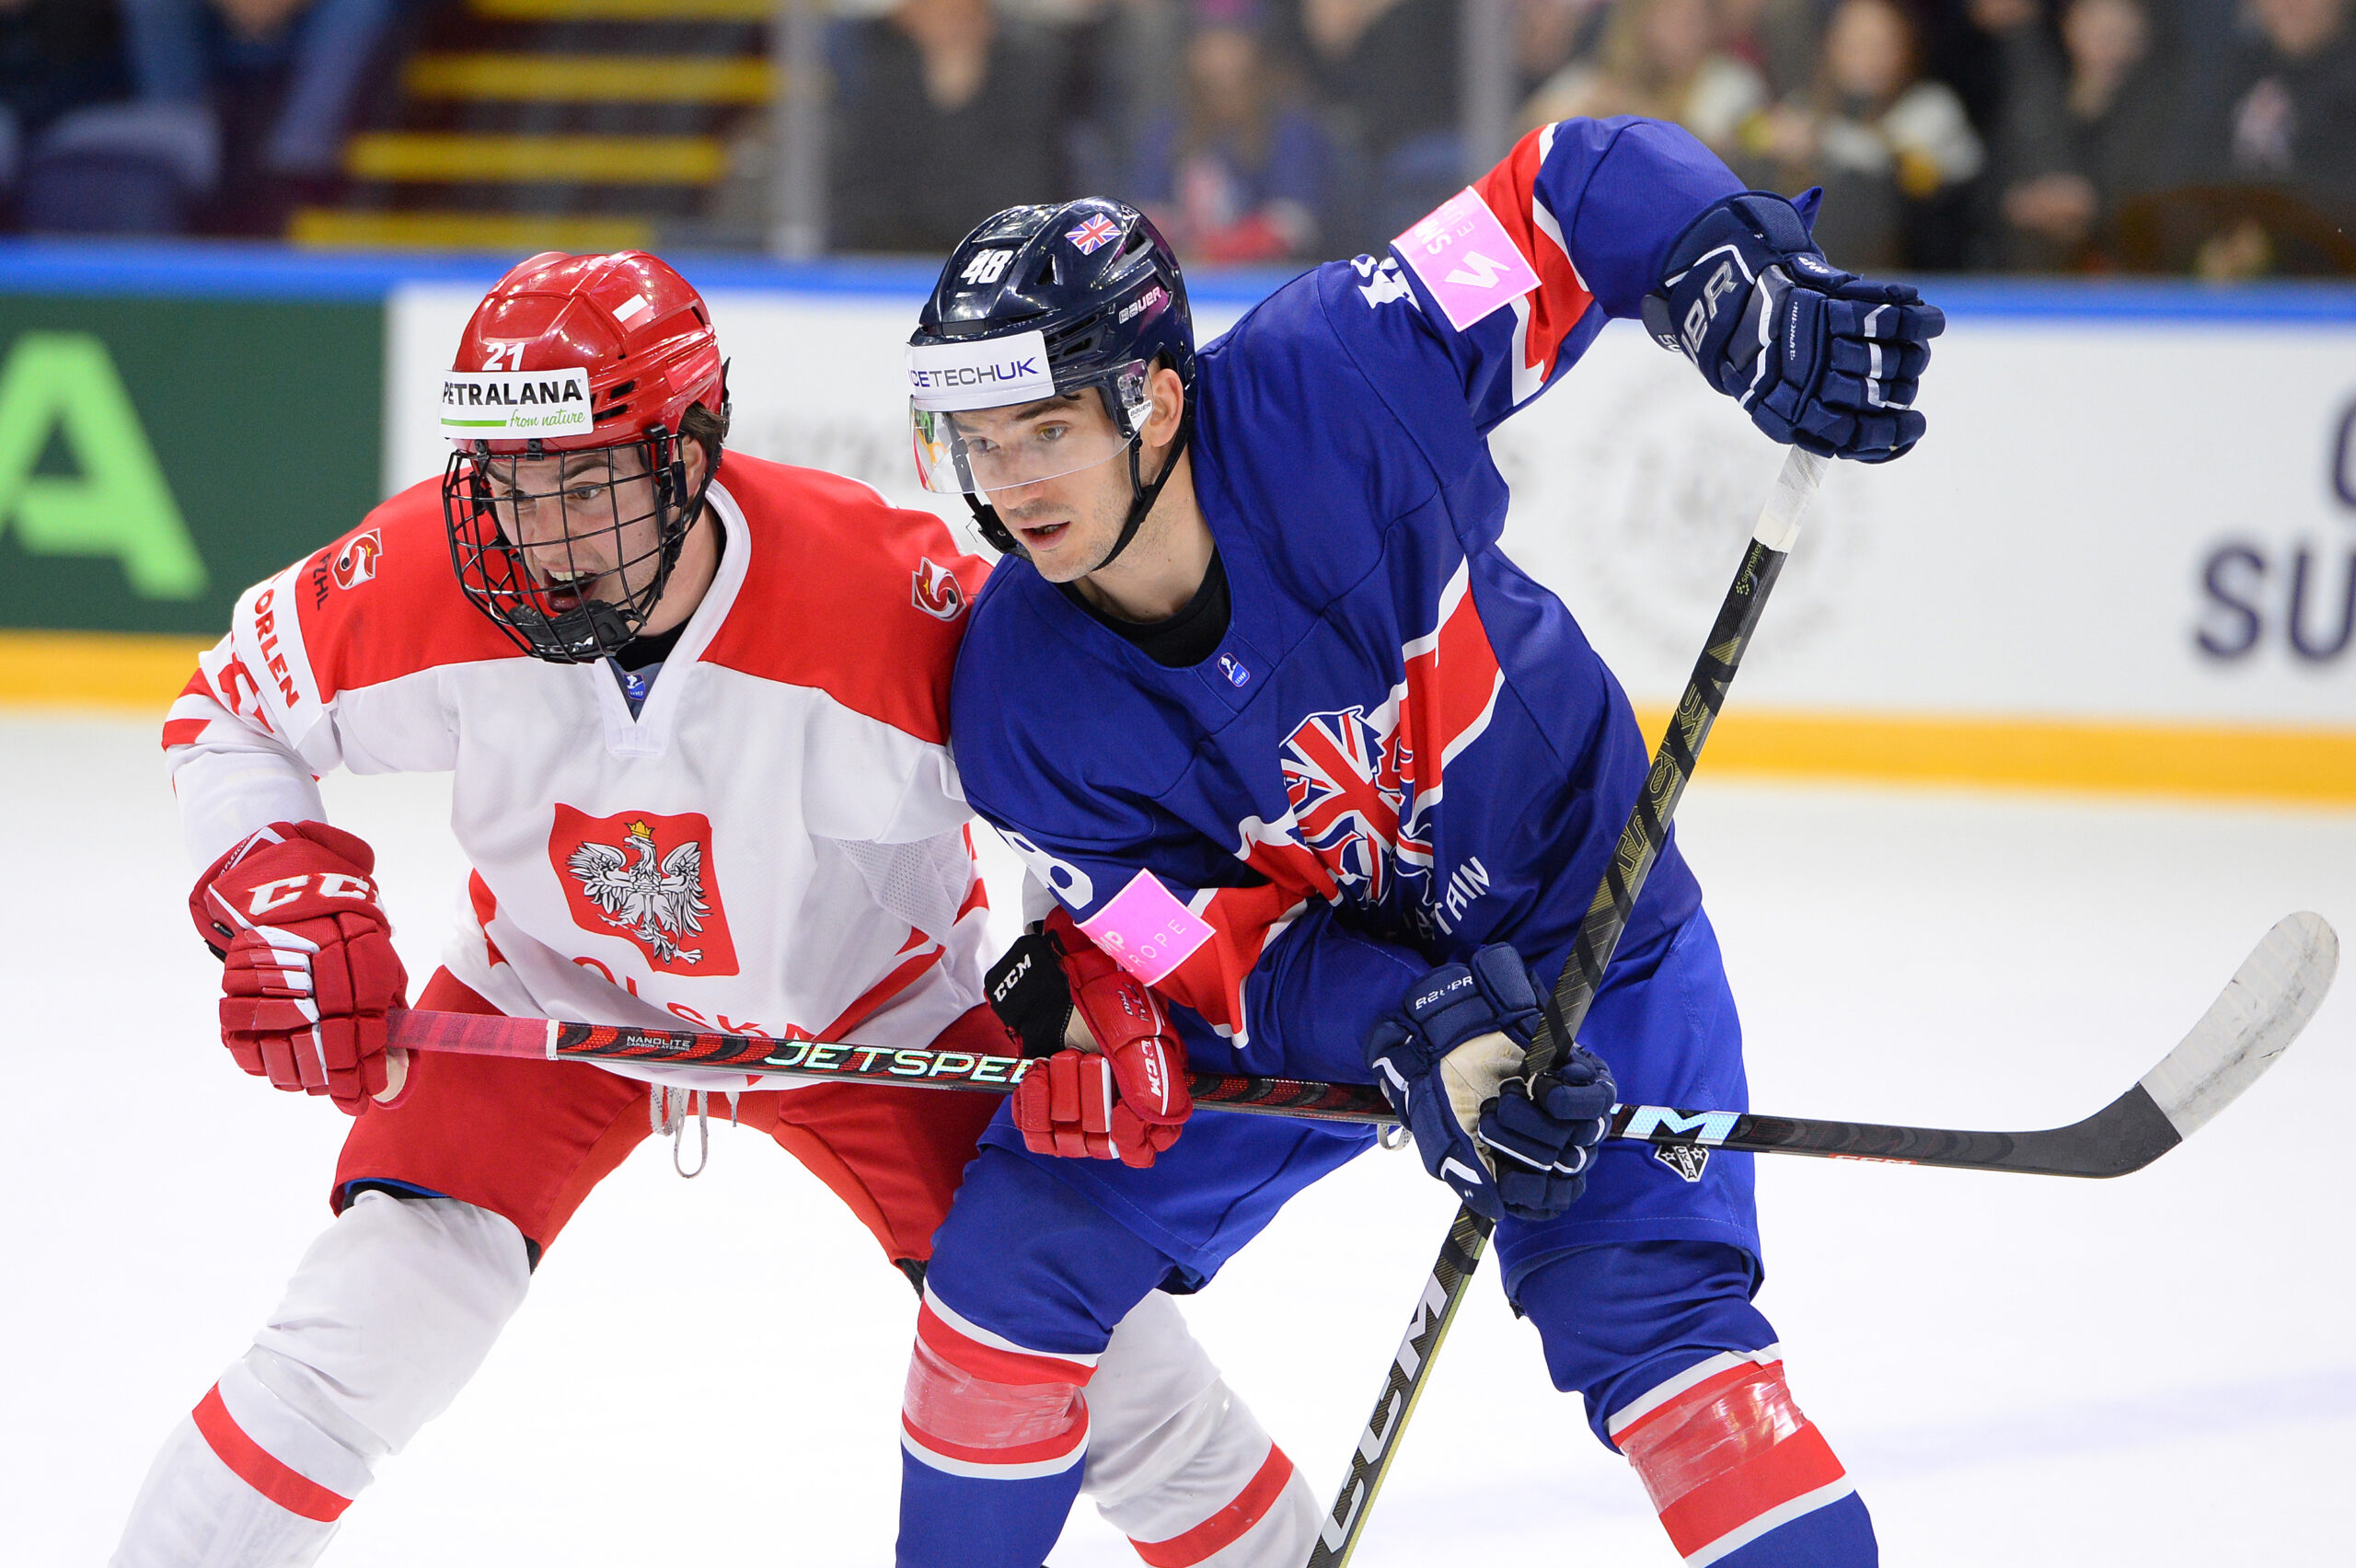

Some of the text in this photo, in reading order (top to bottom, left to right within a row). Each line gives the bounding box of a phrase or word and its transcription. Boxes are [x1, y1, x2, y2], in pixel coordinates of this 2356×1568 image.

[960, 248, 1014, 285] 48
[1118, 286, 1162, 324] BAUER
[481, 346, 526, 371] 21
[907, 357, 1040, 388] CETECHUK
[442, 379, 583, 406] PETRALANA
[510, 408, 586, 428] from nature
[0, 329, 208, 598] A
[2196, 545, 2356, 663] SU
[254, 588, 301, 709] ORLEN
[993, 953, 1032, 1003] CCM
[1116, 989, 1133, 1017] PRO
[627, 1035, 691, 1047] NANOLITE
[1138, 1039, 1162, 1098] CCM
[1320, 1271, 1449, 1555] CCM
